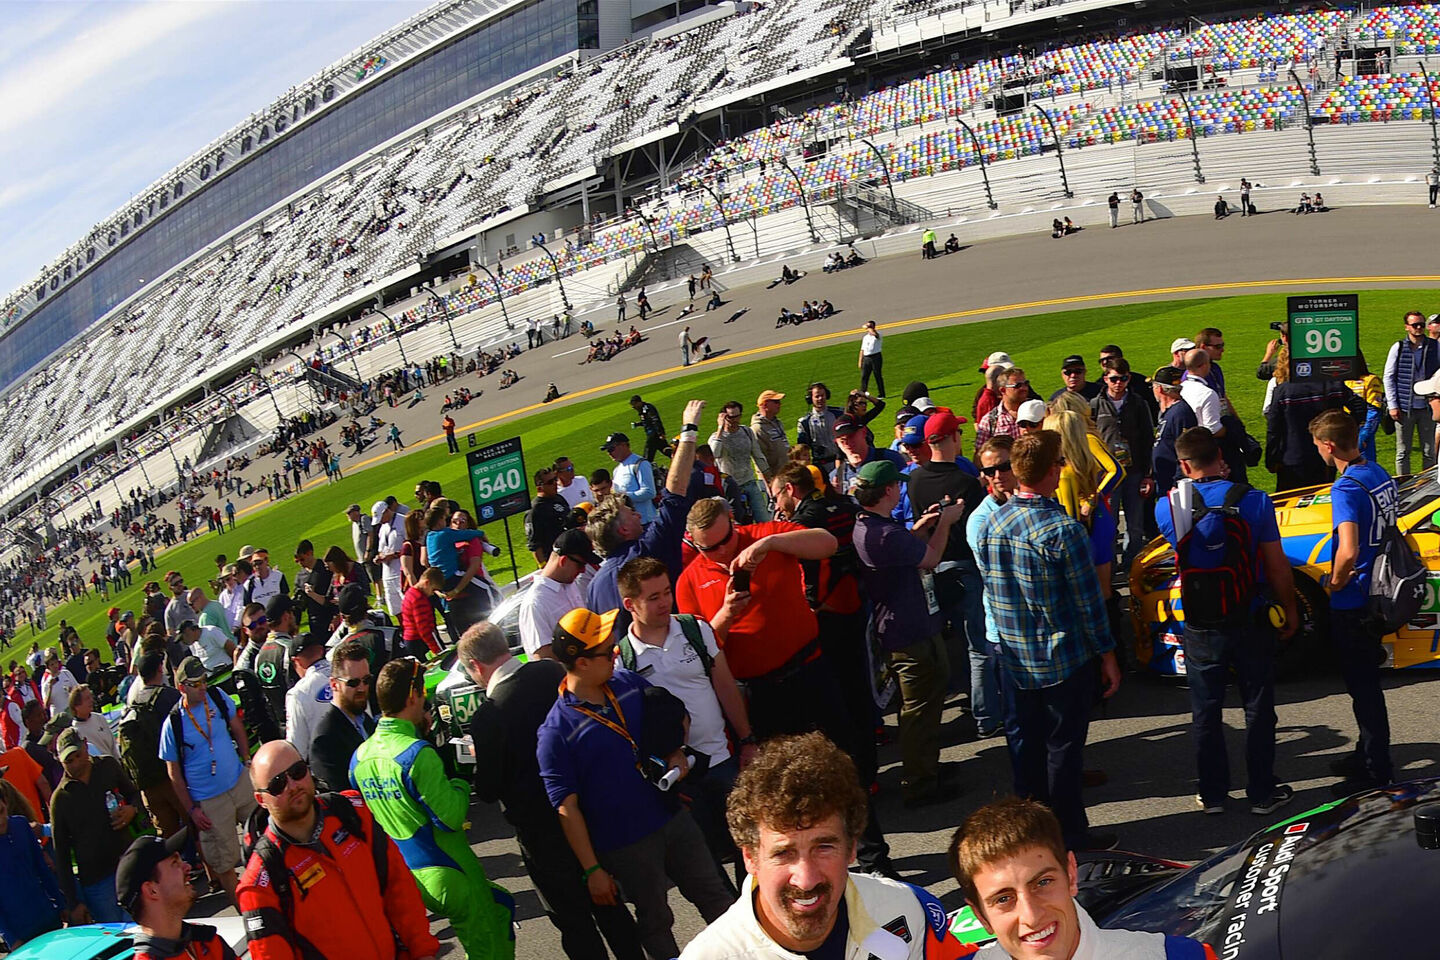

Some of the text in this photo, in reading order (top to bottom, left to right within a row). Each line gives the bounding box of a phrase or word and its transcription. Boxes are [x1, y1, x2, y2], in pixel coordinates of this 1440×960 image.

[36, 85, 335, 302] WORLD CENTER OF RACING
[1294, 316, 1314, 324] GTD
[1305, 328, 1342, 354] 96
[478, 468, 521, 499] 540
[1235, 842, 1275, 909] customer
[1256, 835, 1304, 916] Audi Sport
